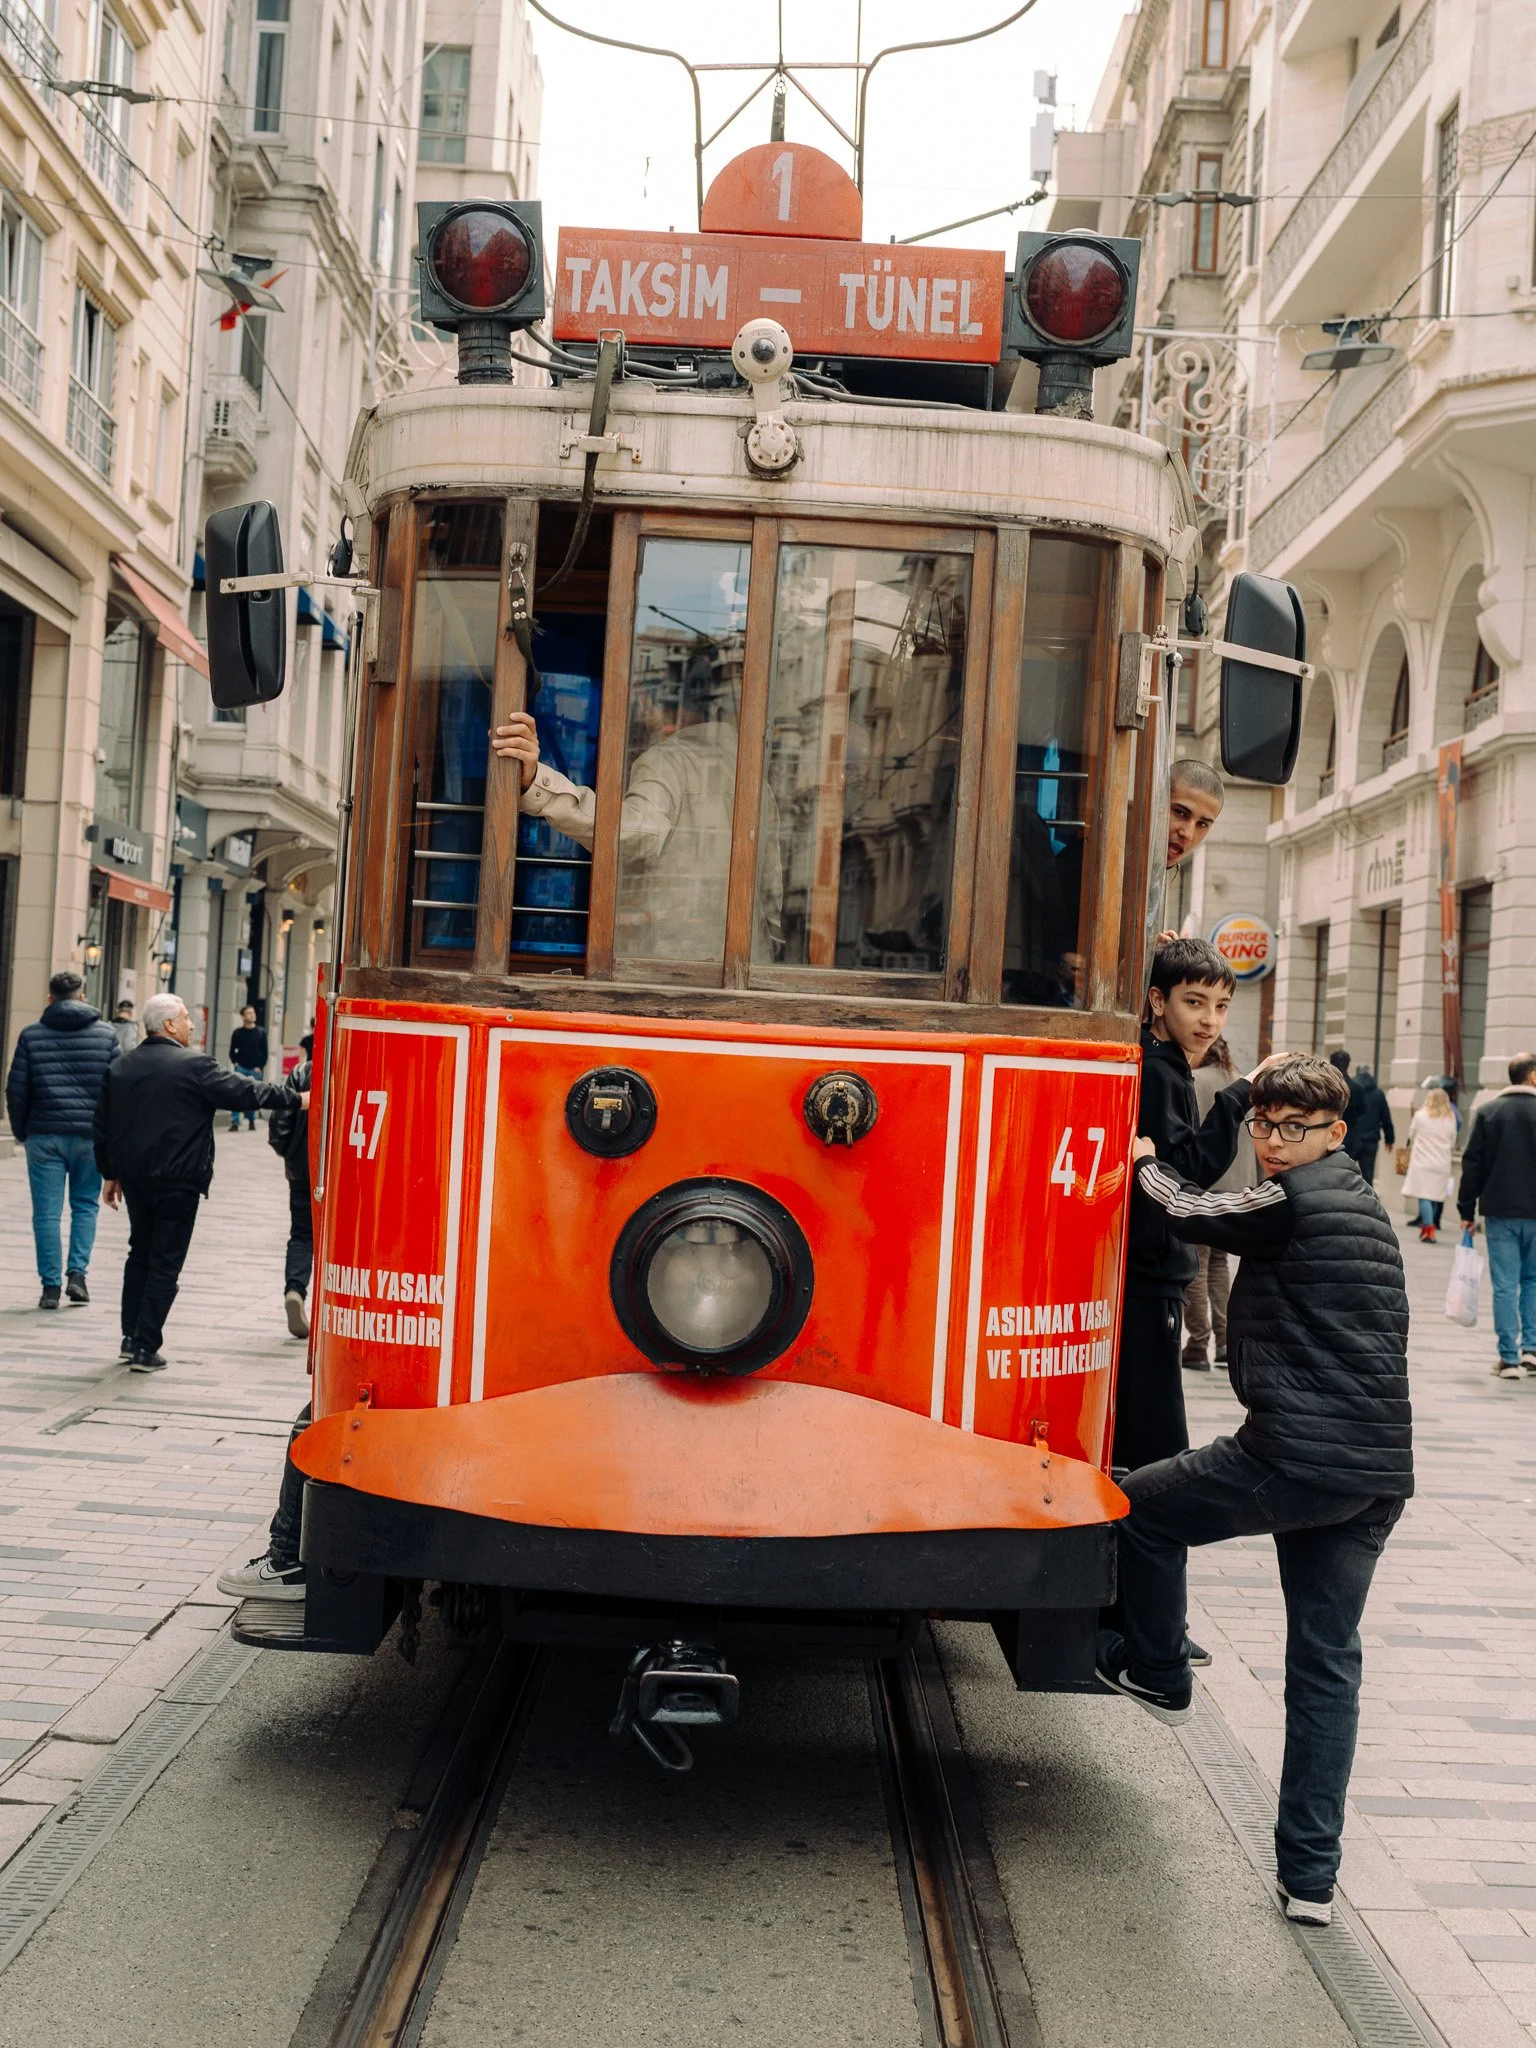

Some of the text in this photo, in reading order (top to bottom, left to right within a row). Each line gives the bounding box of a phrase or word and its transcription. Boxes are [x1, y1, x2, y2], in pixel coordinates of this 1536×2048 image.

[772, 151, 794, 222] 1
[565, 247, 729, 321] TAKSİM
[839, 258, 983, 336] TÜNEL
[1219, 944, 1268, 959] KING
[349, 1090, 388, 1160] 47
[1051, 1126, 1106, 1197] 47
[376, 1268, 445, 1305] YASAK
[332, 1304, 442, 1348] TEHLİKELİDİR
[986, 1303, 1075, 1337] ASILMAK
[986, 1349, 1012, 1380] VE
